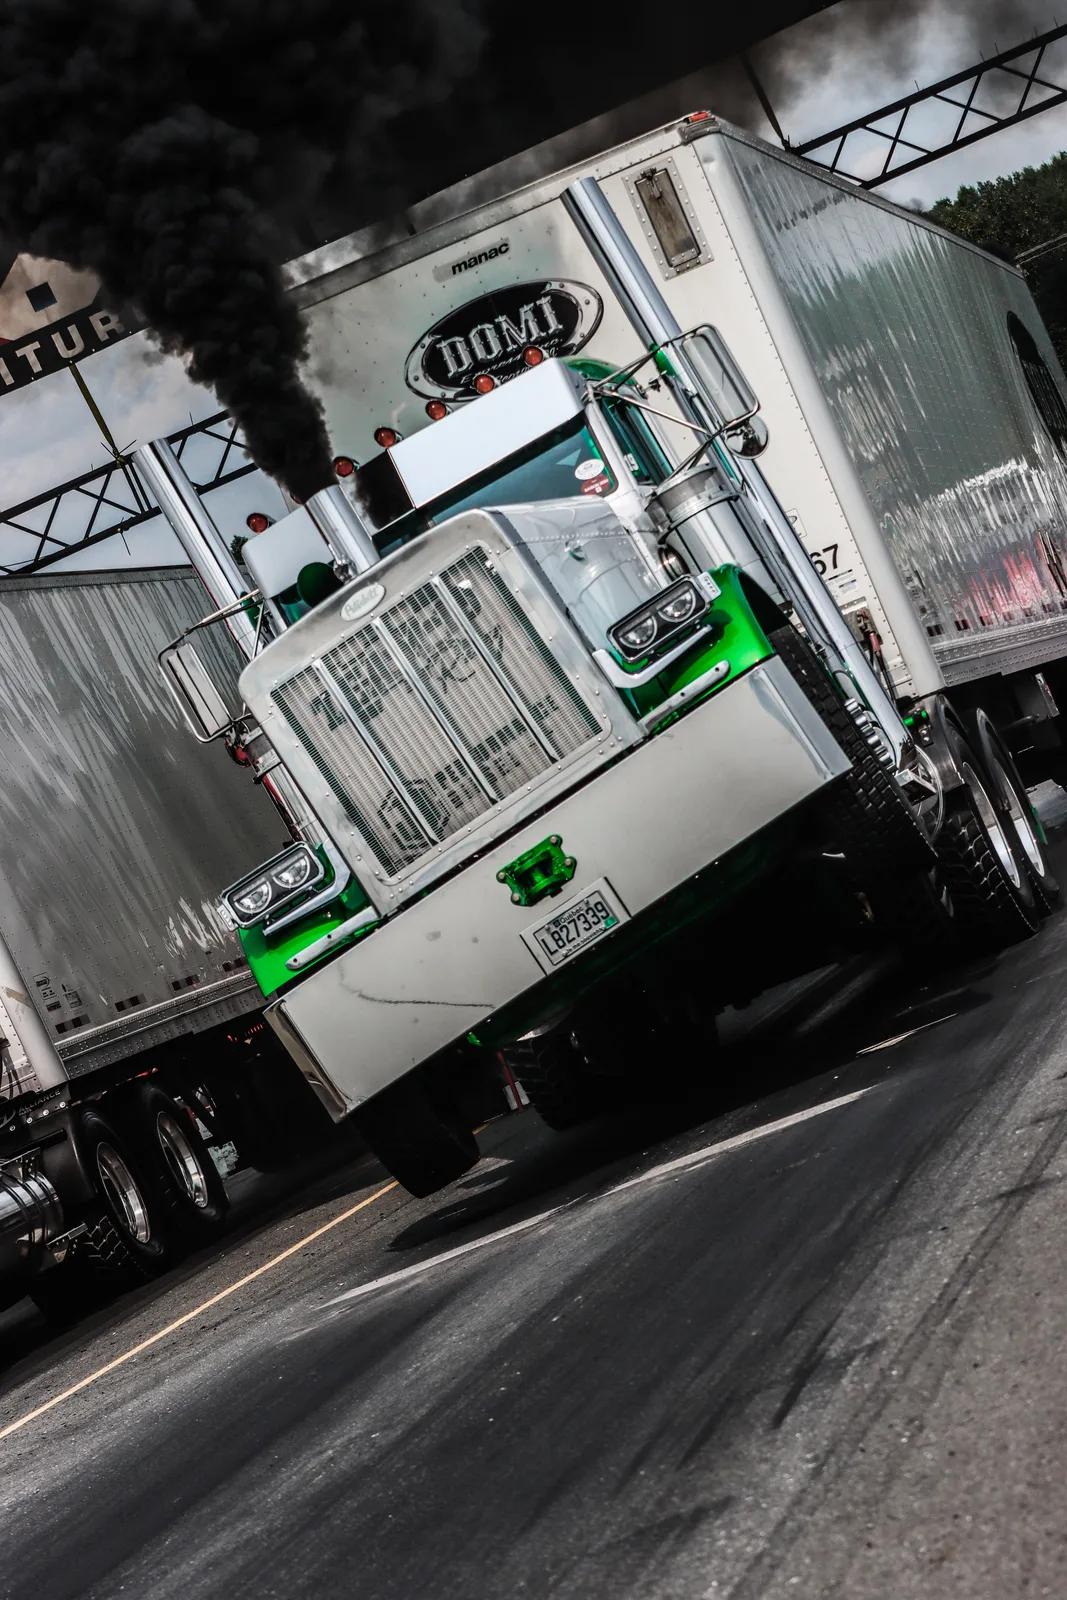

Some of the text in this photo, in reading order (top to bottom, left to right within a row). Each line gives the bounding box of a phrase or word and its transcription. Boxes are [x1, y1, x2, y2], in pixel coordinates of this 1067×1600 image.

[452, 242, 510, 275] manac
[435, 296, 564, 378] DOMI
[810, 543, 839, 576] 67
[434, 693, 560, 791] PERORMACE
[541, 901, 610, 956] L827339
[19, 1089, 61, 1113] ALLIANCE
